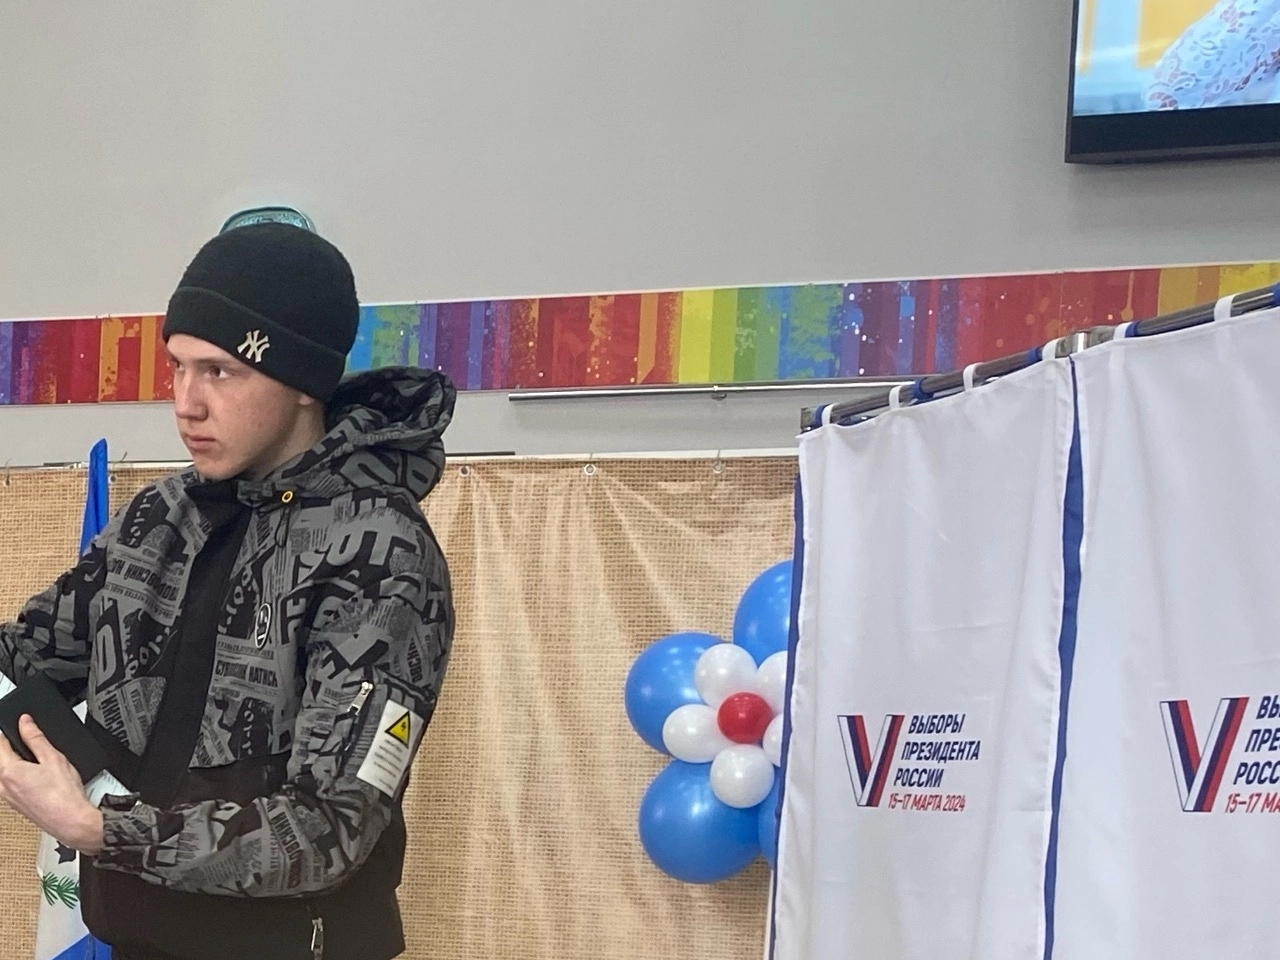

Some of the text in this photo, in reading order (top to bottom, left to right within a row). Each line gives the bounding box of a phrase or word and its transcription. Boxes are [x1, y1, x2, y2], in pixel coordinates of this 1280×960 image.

[908, 714, 966, 734] ВЫБОРЫ
[901, 740, 981, 764] ПРЕЗИДЕНТА
[893, 768, 944, 788] РОССИИ
[911, 794, 942, 811] МАРТА
[942, 795, 966, 812] 2024
